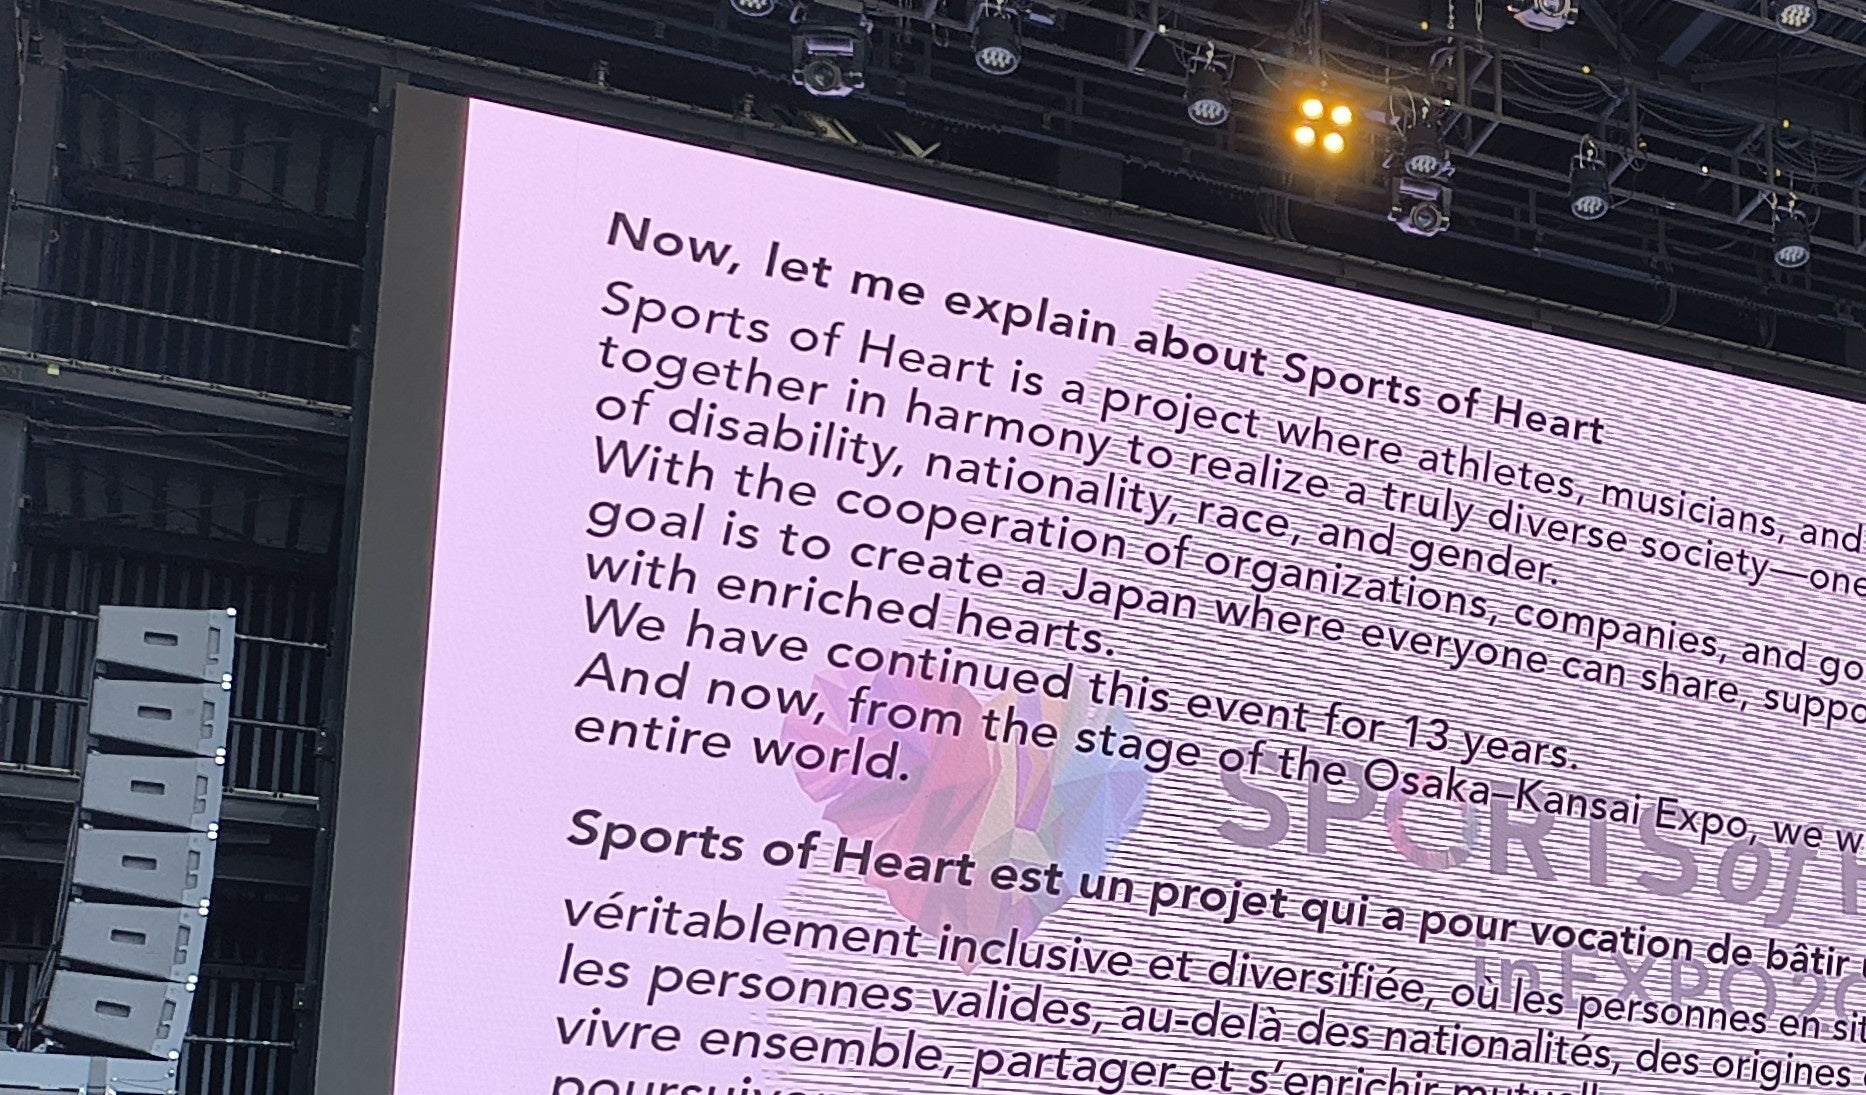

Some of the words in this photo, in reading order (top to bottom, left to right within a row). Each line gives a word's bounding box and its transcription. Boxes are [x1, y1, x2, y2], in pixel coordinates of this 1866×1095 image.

[600, 279, 770, 344] Sports
[788, 320, 846, 358] of
[857, 328, 995, 389] Heart
[1009, 358, 1044, 397] is
[1060, 379, 1086, 406] a
[1099, 386, 1261, 440] project
[1276, 414, 1404, 466] where
[1417, 443, 1585, 508] athletes,
[1600, 482, 1786, 545] musicians,
[1799, 521, 1864, 555] and
[606, 210, 741, 276] Now,
[764, 240, 834, 289] let
[850, 269, 926, 307] me
[944, 290, 1117, 348] explain
[1133, 322, 1268, 378] about
[1281, 351, 1422, 409] Sports
[1436, 385, 1483, 420] of
[1493, 393, 1606, 446] Heart
[595, 387, 656, 427] of
[667, 396, 904, 479] disability,
[924, 452, 1179, 527] nationality,
[1196, 500, 1301, 548] race,
[1316, 520, 1397, 558] and
[1407, 538, 1559, 587] gender.
[598, 335, 829, 407] together
[844, 376, 886, 419] in
[905, 385, 1112, 468] harmony
[1126, 433, 1174, 470] to
[1188, 451, 1330, 499] realize
[1344, 481, 1367, 507] a
[1380, 481, 1476, 534] truly
[1487, 497, 1629, 554] diverse
[584, 500, 706, 542] goal
[721, 509, 761, 551] is
[778, 522, 832, 561] to
[849, 542, 1004, 589] create
[1020, 569, 1047, 597] a
[1060, 566, 1198, 622] Japan
[1214, 592, 1346, 643] where
[1360, 623, 1549, 675] everyone
[1561, 655, 1626, 689] can
[1639, 659, 1749, 713] share,
[585, 548, 697, 595] with
[715, 574, 942, 632] enriched
[955, 595, 1115, 658] hearts.
[594, 434, 715, 492] With
[733, 460, 817, 508] the
[835, 489, 1127, 561] cooperation
[1144, 533, 1194, 571] of
[1204, 551, 1498, 628] organizations,
[1513, 602, 1728, 665] companies,
[1741, 639, 1808, 674] and
[573, 714, 732, 760] entire
[752, 735, 910, 782] world.
[573, 650, 691, 701] And
[706, 677, 826, 726] now,
[847, 684, 963, 738] from
[981, 704, 1059, 749] the
[1074, 723, 1202, 775] stage
[1217, 738, 1268, 776] of
[1277, 743, 1348, 787] the
[1654, 795, 1758, 847] Expo,
[1770, 819, 1824, 849] we
[584, 593, 666, 643] We
[685, 607, 809, 663] have
[826, 642, 1075, 701] continued
[1087, 668, 1171, 714] this
[1185, 693, 1311, 734] event
[1322, 700, 1387, 744] for
[1403, 713, 1451, 752] 13
[1458, 729, 1579, 772] years.
[563, 890, 923, 959] véritablement
[937, 922, 1134, 978] inclusive
[1147, 949, 1195, 984] et
[1207, 947, 1437, 1013] diversifiée,
[1450, 974, 1500, 1011] où
[1512, 976, 1565, 1017] les
[1576, 994, 1768, 1035] personnes
[1778, 1013, 1821, 1041] en
[566, 807, 745, 863] Sports
[762, 829, 823, 871] of
[832, 835, 977, 888] Heart
[989, 862, 1065, 897] est
[1078, 872, 1135, 905] un
[1147, 879, 1289, 926] projet
[1300, 892, 1371, 935] qui
[1380, 906, 1406, 932] a
[1417, 908, 1519, 946] pour
[1529, 921, 1694, 963] vocation
[1705, 931, 1754, 968] de
[1765, 936, 1852, 978] bâtir
[558, 942, 631, 990] les
[646, 964, 915, 1013] personnes
[931, 979, 1104, 1035] valides,
[1120, 998, 1283, 1044] au-delà
[1296, 1007, 1370, 1050] des
[1383, 1022, 1622, 1077] nationalités,
[1634, 1037, 1700, 1077] des
[1711, 1047, 1852, 1093] origines
